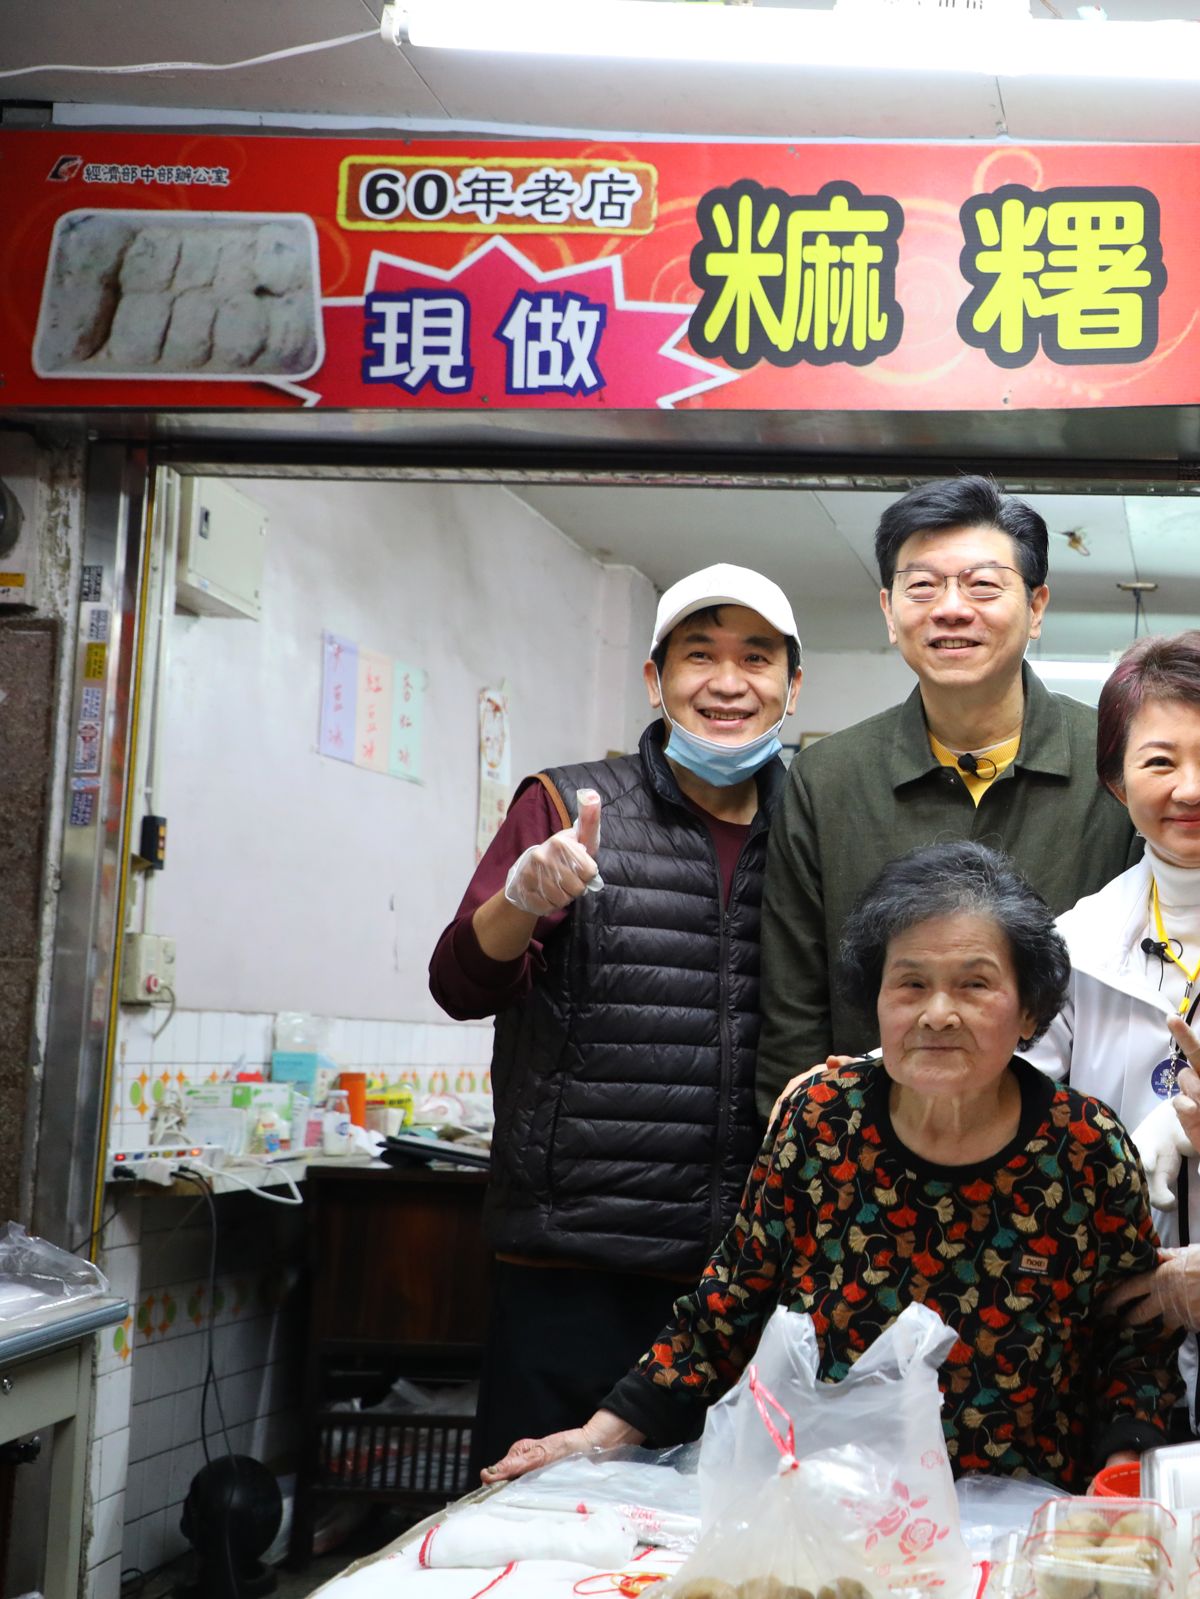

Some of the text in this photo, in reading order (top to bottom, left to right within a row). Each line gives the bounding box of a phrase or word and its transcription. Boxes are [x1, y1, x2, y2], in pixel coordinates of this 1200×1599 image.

[84, 164, 229, 185] 經濟部中部辦公室
[363, 171, 637, 222] 60年老店
[369, 297, 601, 389] 現做
